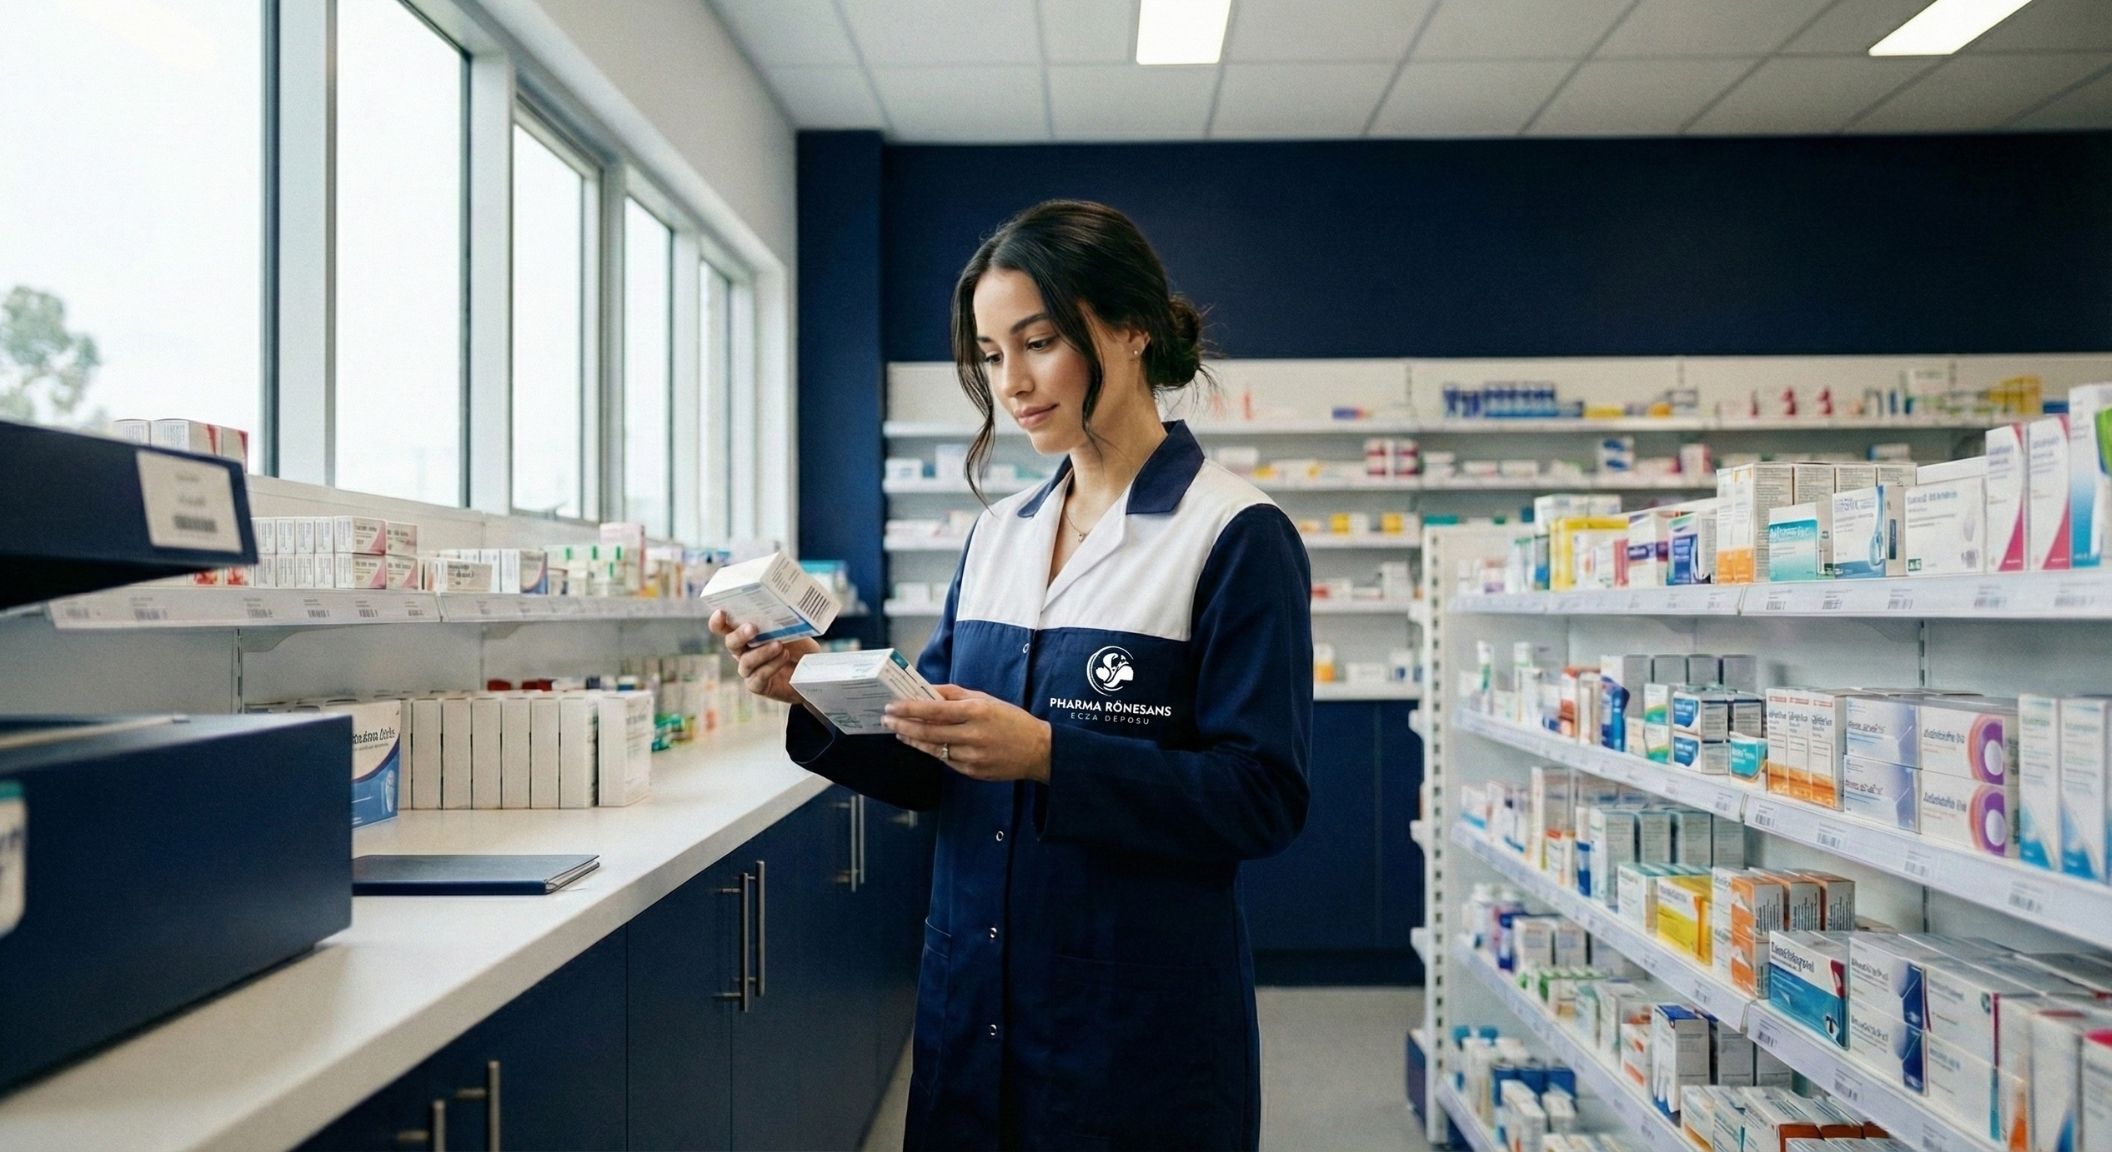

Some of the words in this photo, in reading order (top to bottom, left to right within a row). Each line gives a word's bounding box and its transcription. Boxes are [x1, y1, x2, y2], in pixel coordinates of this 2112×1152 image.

[1050, 698, 1101, 711] PHARMA
[1070, 712, 1098, 721] ECZA
[1105, 715, 1150, 725] DEPOSU
